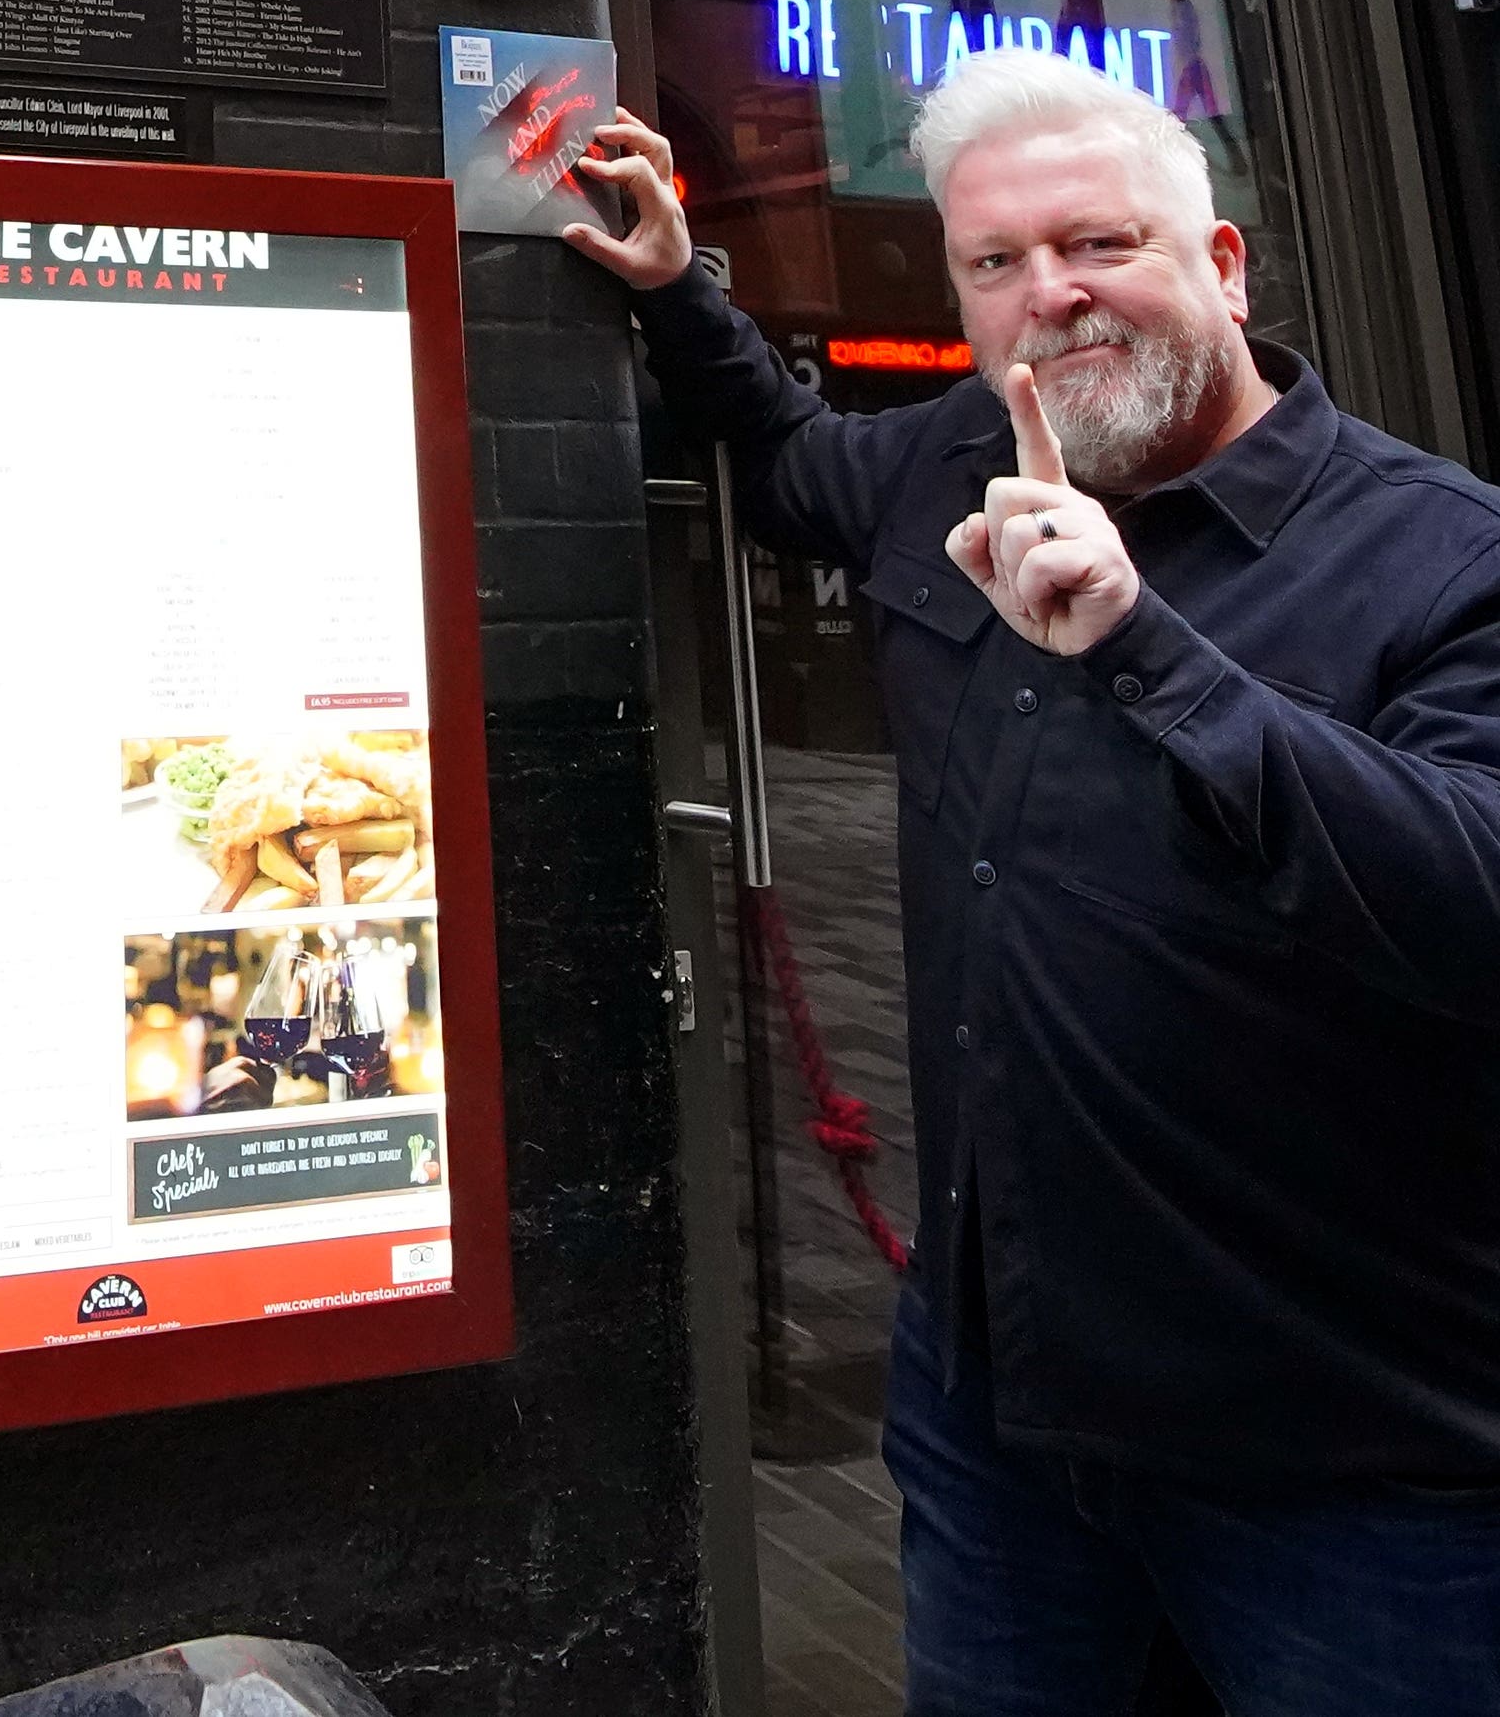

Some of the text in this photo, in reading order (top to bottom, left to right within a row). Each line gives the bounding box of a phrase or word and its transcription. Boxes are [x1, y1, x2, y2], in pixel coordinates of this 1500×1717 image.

[26, 98, 45, 112] Edwin
[67, 100, 83, 114] Lord
[84, 101, 104, 118] Mayor
[105, 103, 113, 116] of
[114, 103, 144, 121] Liverpool
[145, 105, 151, 118] in
[477, 62, 531, 126] NOW
[23, 120, 35, 133] the
[36, 121, 49, 136] City
[50, 121, 58, 134] of
[59, 122, 89, 139] Liverpool
[90, 124, 97, 136] in
[98, 124, 109, 137] the
[110, 125, 139, 141] unveiling
[140, 126, 147, 139] of
[148, 127, 161, 140] this
[508, 105, 552, 164] AND
[529, 130, 587, 201] THEN
[49, 223, 269, 269] CAVERN
[156, 1143, 205, 1177] Chef's
[241, 1142, 260, 1156] DON'T
[262, 1140, 284, 1154] FORGET
[288, 1139, 295, 1152] TO
[298, 1138, 308, 1151] TRY
[311, 1136, 324, 1149] OUR
[327, 1133, 357, 1148] DELICIOUS
[242, 1164, 254, 1177] OUR
[258, 1160, 296, 1176] INGREDIENTS
[298, 1158, 309, 1171] ARE
[312, 1156, 330, 1170] FRESH
[333, 1155, 346, 1168] AND
[349, 1152, 376, 1166] SOURCED
[152, 1167, 219, 1213] Specials
[82, 1279, 142, 1314] CAVERN
[98, 1296, 126, 1309] CLUB
[264, 1281, 452, 1314] www.cavernclubrestaurant.com
